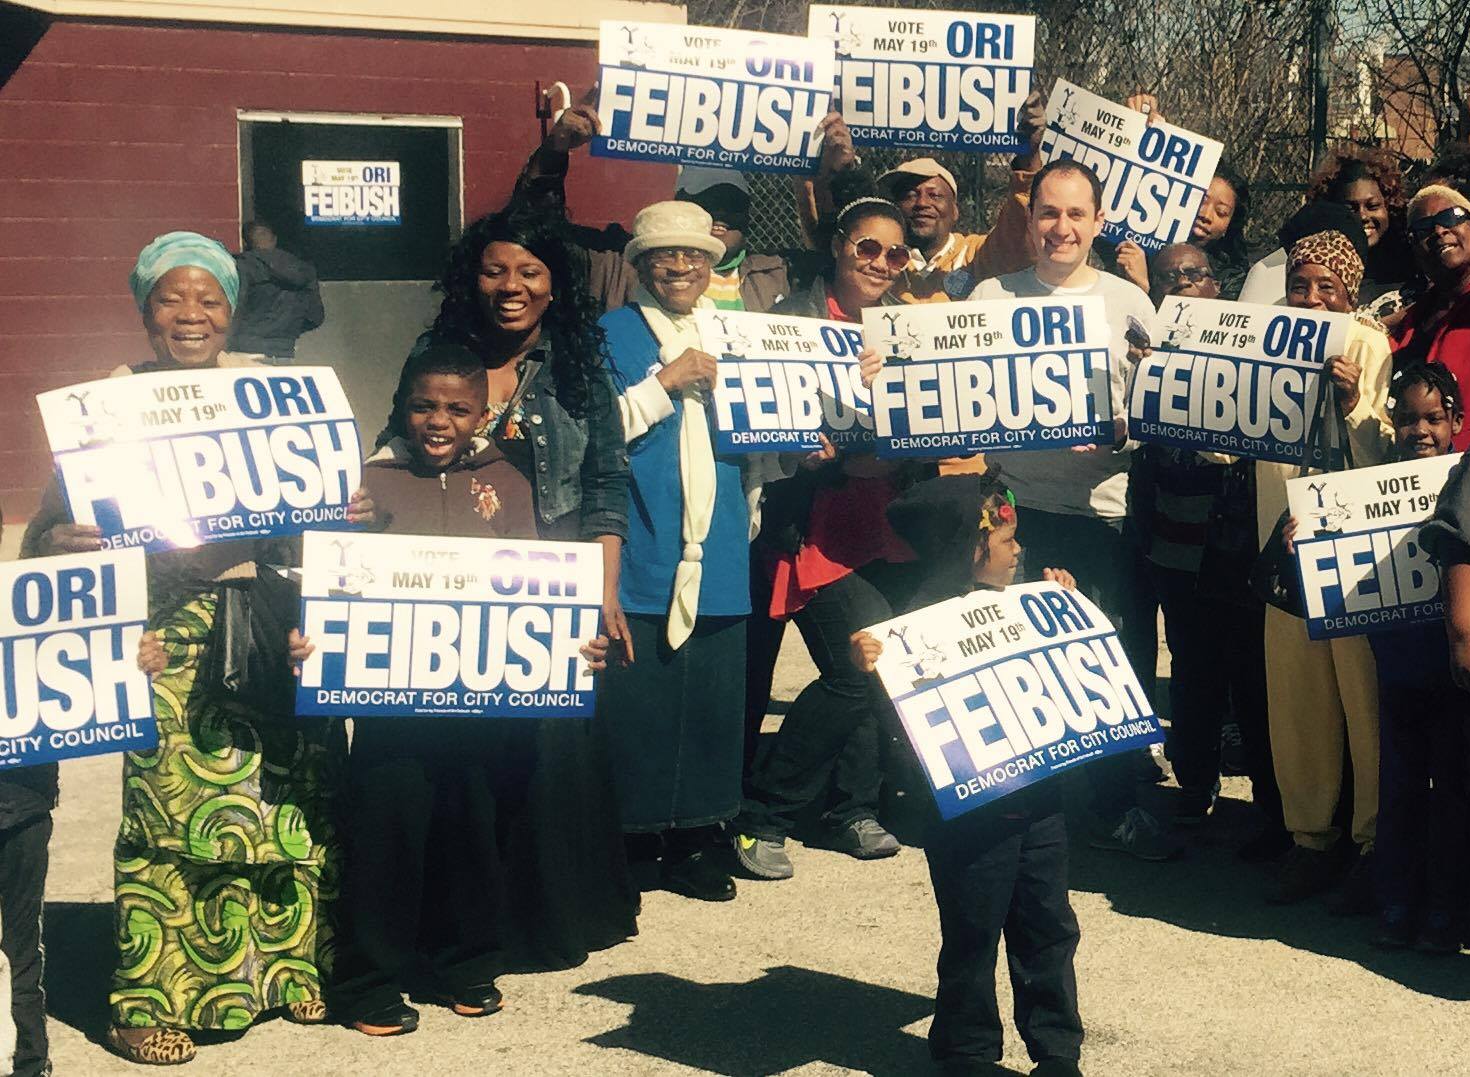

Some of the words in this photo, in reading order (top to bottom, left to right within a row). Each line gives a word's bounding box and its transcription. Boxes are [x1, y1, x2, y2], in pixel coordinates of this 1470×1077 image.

[888, 20, 925, 34] VOTE
[946, 21, 1015, 60] ORI
[684, 36, 723, 49] VOTE
[873, 37, 905, 51] MAY
[911, 39, 938, 53] 19th
[834, 60, 1030, 134] EIBUSH
[599, 67, 830, 158] FEIBUSH
[1095, 108, 1126, 131] VOTE
[851, 127, 894, 140] OCRAT
[899, 130, 925, 142] FOR
[930, 132, 959, 144] CITY
[1081, 120, 1107, 140] MAY
[1108, 132, 1132, 149] 19th
[606, 138, 683, 157] DEMOCRAT
[687, 147, 715, 161] FOR
[718, 151, 750, 164] CITY
[753, 153, 812, 169] COUNCIL
[1137, 126, 1204, 179] ORI
[362, 166, 391, 182] ORI
[304, 186, 400, 216] FEIBUSH
[767, 323, 801, 337] VOTE
[946, 312, 987, 329] VOTE
[1011, 305, 1087, 348] ORI
[1218, 312, 1251, 329] VOTE
[761, 338, 792, 353] MAY
[819, 325, 864, 358] OR
[934, 334, 968, 350] MAY
[973, 331, 1004, 347] 19th
[1199, 329, 1229, 345] MAY
[1231, 332, 1257, 349] 19th
[1262, 314, 1331, 363] ORI
[152, 383, 205, 403] VOTE
[233, 375, 327, 420] ORI
[872, 351, 1112, 438] FEIBUSH
[141, 407, 186, 427] MAY
[191, 402, 228, 422] 19th
[731, 431, 800, 445] DEMOCRAT
[803, 431, 823, 443] FO
[830, 431, 859, 443] CITY
[890, 434, 968, 450] DEMOCRAT
[971, 432, 1001, 445] FOR
[1004, 429, 1037, 443] CITY
[1041, 426, 1106, 440] COUNCIL
[1141, 421, 1208, 442] DEMOCRAT
[1212, 433, 1238, 447] FOR
[1241, 438, 1270, 452] CITY
[1376, 474, 1421, 496] VOTE
[207, 515, 244, 532] FOR
[248, 511, 286, 528] CITY
[291, 505, 349, 524] COUNCI
[1364, 500, 1402, 520] MAY
[1407, 493, 1439, 513] 19th
[391, 571, 434, 589] MAY
[441, 572, 478, 590] 19th
[490, 549, 578, 597] ORI
[12, 563, 117, 627] ORI
[960, 603, 1005, 629] VOTE
[1019, 589, 1096, 639] ORI
[1324, 608, 1408, 630] DEMOCRAT
[1413, 601, 1446, 616] FOR
[301, 600, 600, 692] FEIBUSH
[957, 633, 997, 658] MAY
[999, 621, 1027, 645] 19th
[316, 689, 417, 706] DEMOCRAT
[422, 691, 458, 706] FOR
[463, 691, 503, 707] CITY
[508, 692, 584, 708] COUNCIL
[897, 635, 1154, 790] FEIBUSH
[49, 723, 145, 749] COUNCIL
[954, 751, 1047, 800] DEMOCRAT
[1048, 738, 1081, 761] FOR
[1082, 730, 1109, 750] CITY
[1109, 719, 1157, 740] COUNCIL
